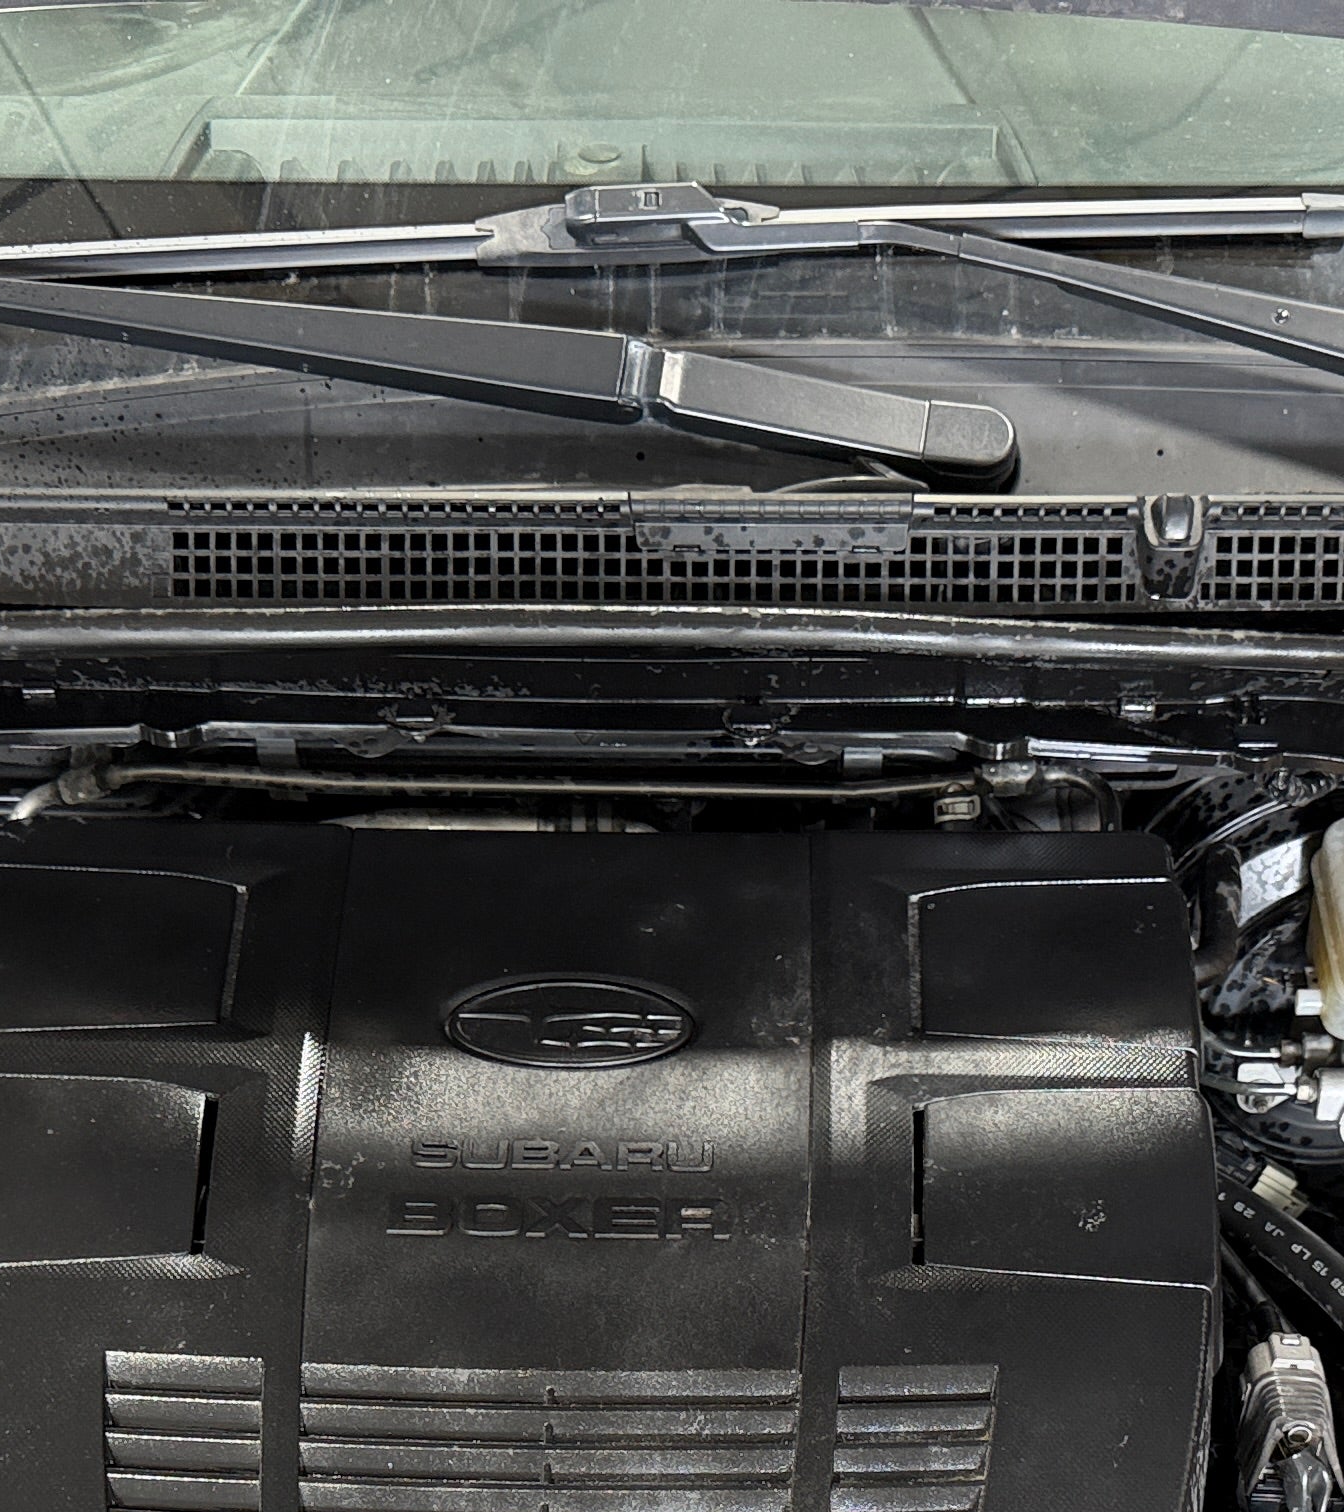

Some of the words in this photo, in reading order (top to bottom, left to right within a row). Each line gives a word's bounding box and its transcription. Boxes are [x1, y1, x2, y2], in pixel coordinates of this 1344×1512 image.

[412, 1138, 714, 1172] SUBARU
[386, 1195, 734, 1240] BOXER
[1264, 1222, 1285, 1237] JA
[1291, 1243, 1312, 1261] LP
[1312, 1259, 1331, 1277] 15
